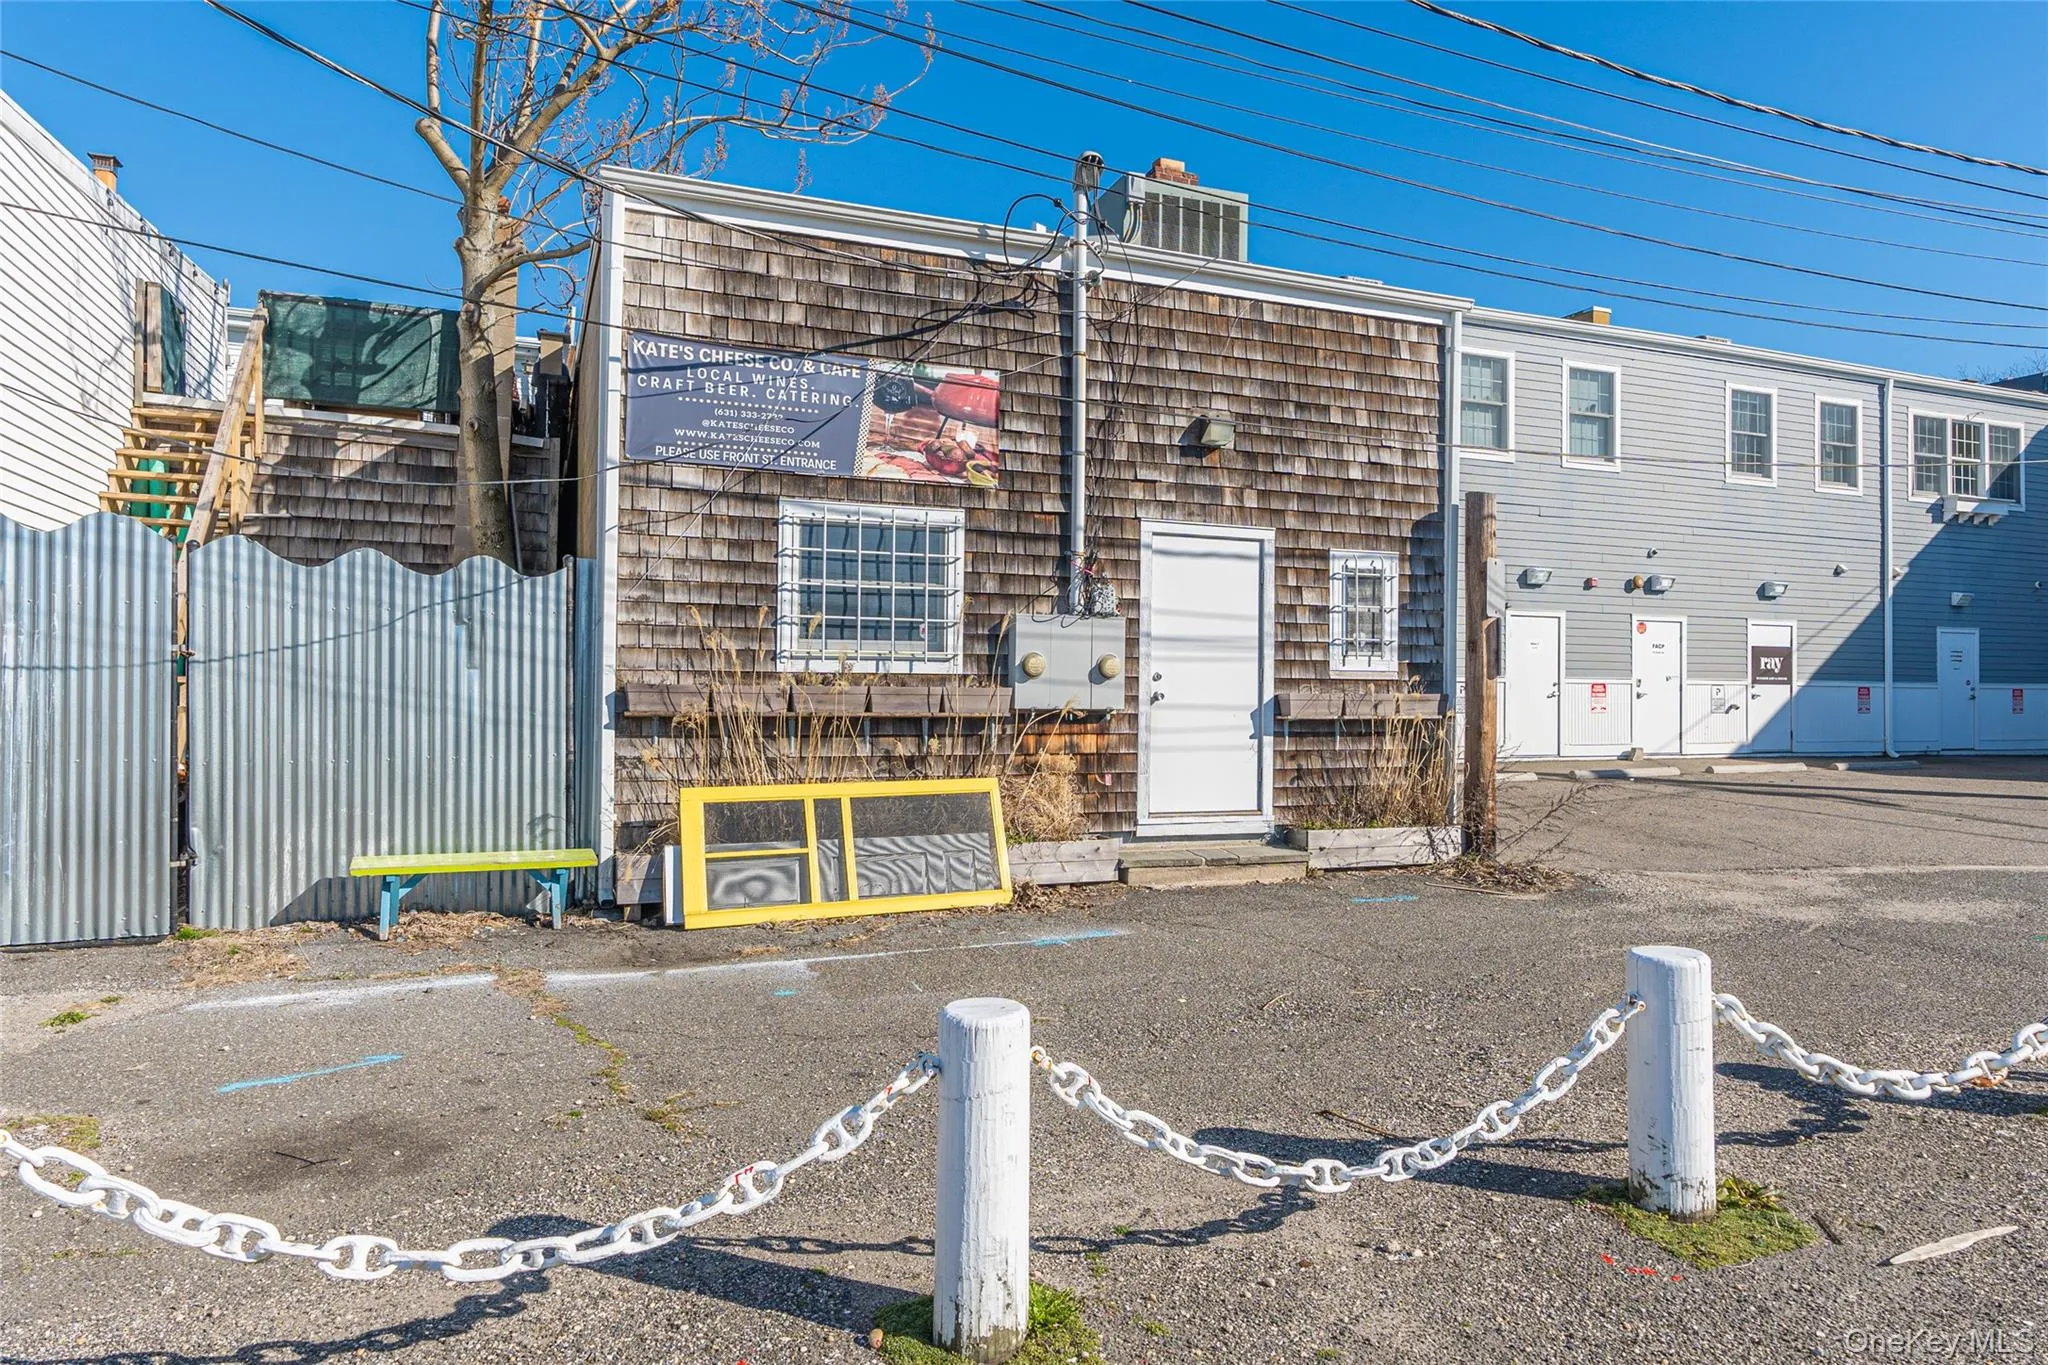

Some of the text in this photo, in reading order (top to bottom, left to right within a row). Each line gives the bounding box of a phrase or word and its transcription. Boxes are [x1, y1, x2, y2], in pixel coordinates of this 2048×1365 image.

[633, 338, 861, 379] KATE'S CHEESE CO. & CAFE
[687, 366, 815, 390] LOCAL WINES.
[637, 374, 859, 408] CRAFT BEER. CATERING.
[714, 408, 738, 418] (631)
[673, 428, 821, 449] WWW.KATESCHEESECOCOM
[655, 445, 837, 470] PLEASE USE FRONT ST. ENTRANCE
[1760, 656, 1784, 674] ray
